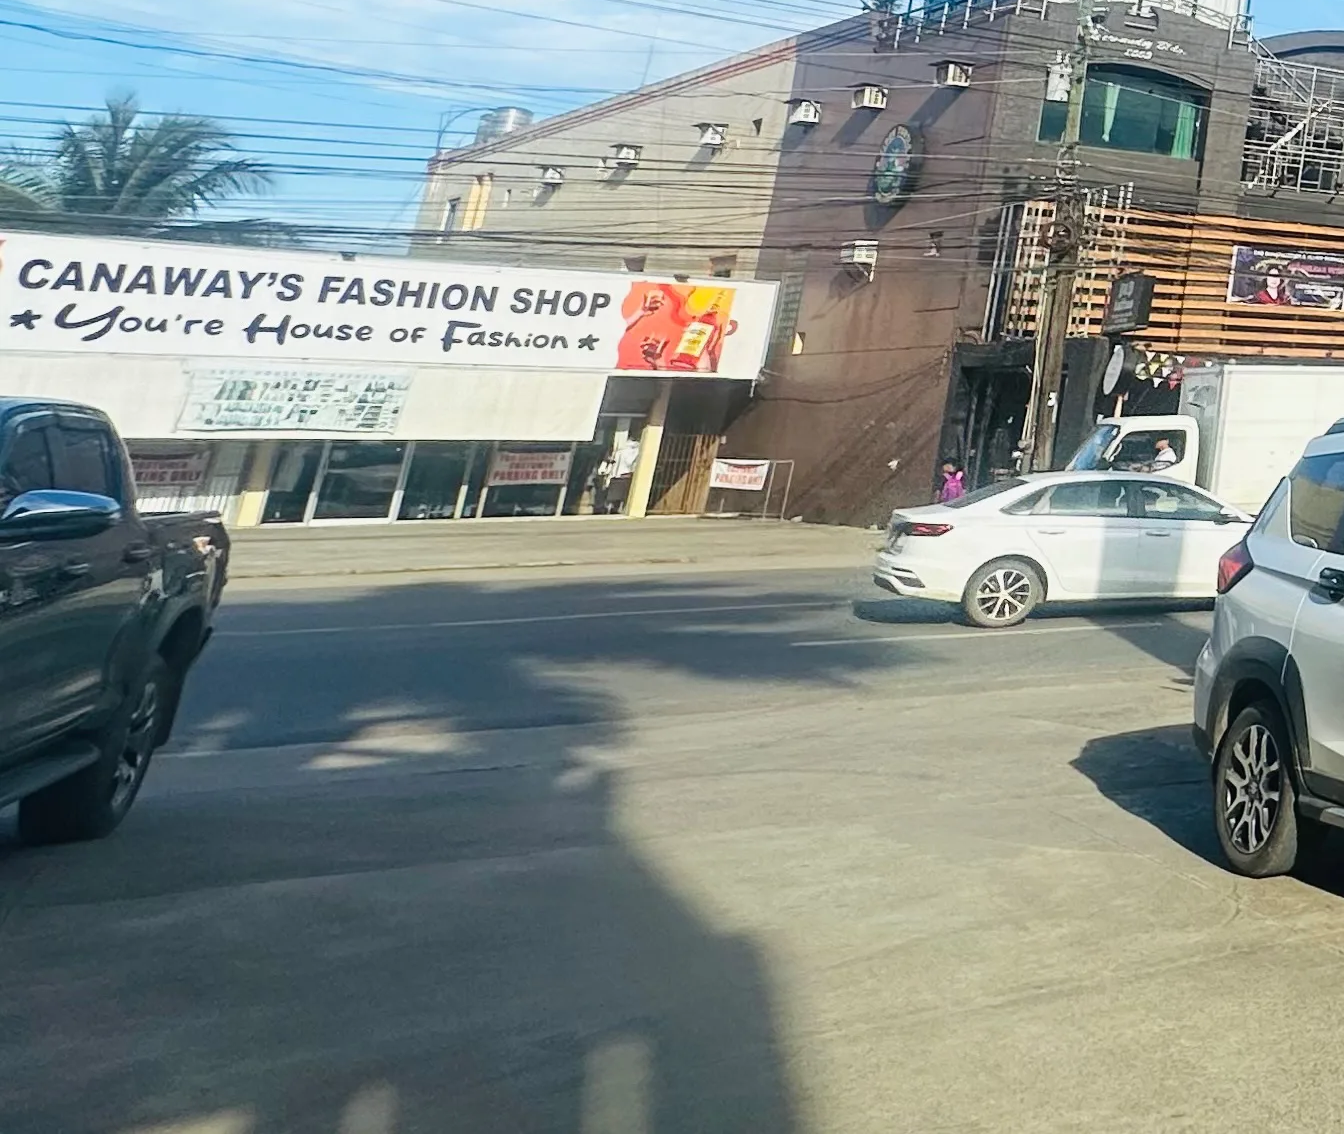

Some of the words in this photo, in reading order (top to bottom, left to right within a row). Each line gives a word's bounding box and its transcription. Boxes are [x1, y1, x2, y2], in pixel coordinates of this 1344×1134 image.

[18, 258, 304, 303] CANAWAY'S
[317, 275, 499, 312] FASHION
[510, 287, 611, 317] SHOP
[54, 302, 225, 342] You're
[242, 313, 374, 346] House
[441, 320, 569, 353] Fashion
